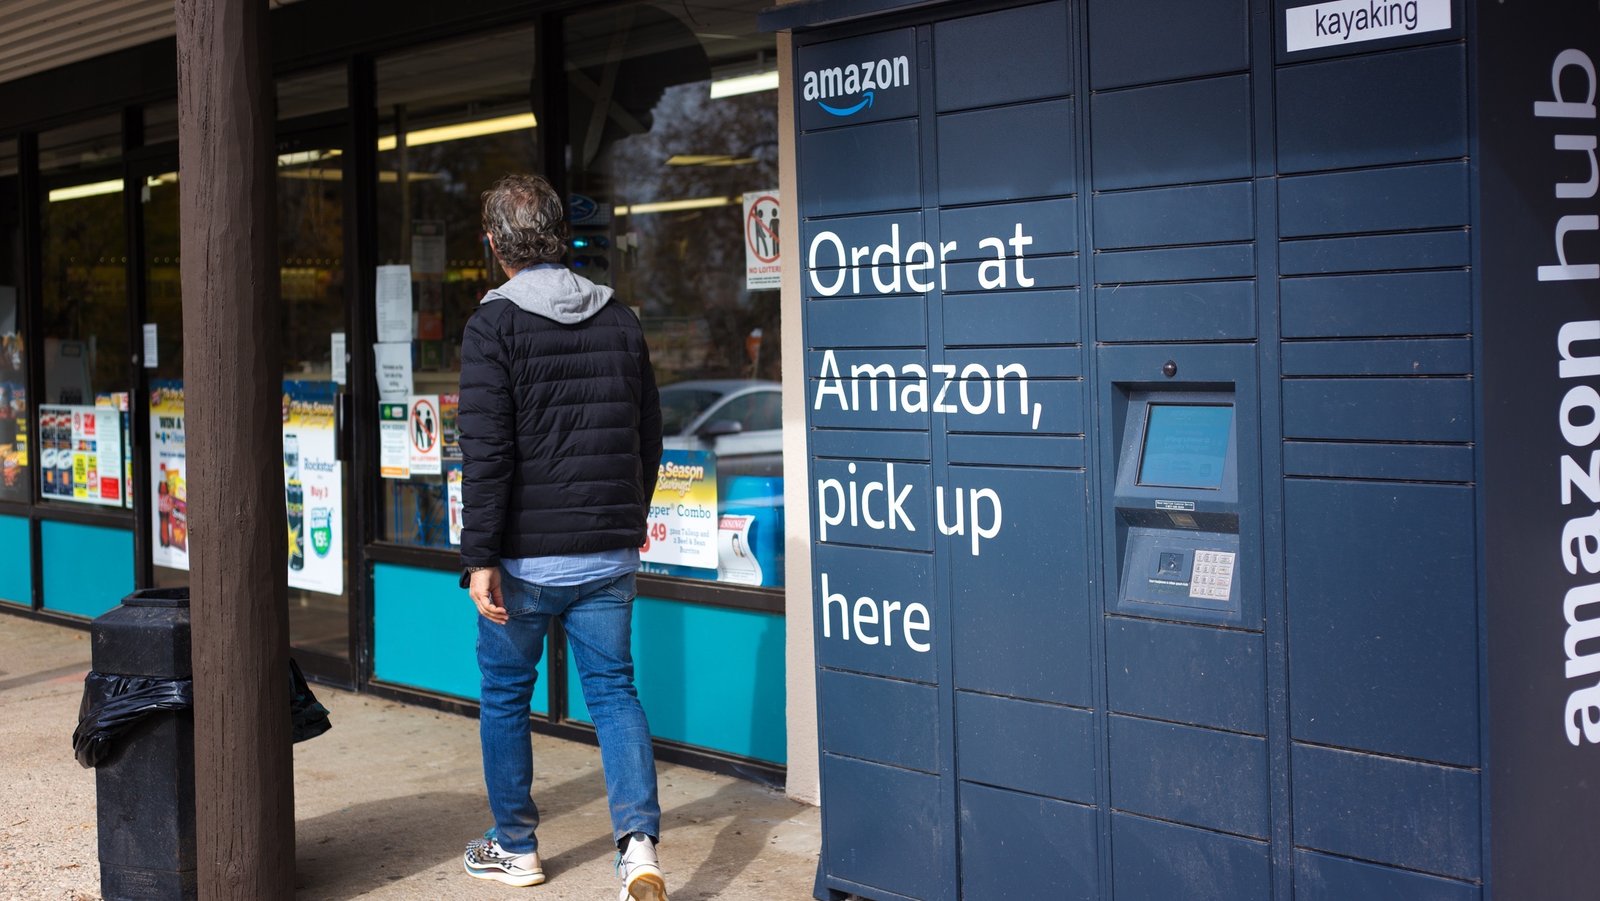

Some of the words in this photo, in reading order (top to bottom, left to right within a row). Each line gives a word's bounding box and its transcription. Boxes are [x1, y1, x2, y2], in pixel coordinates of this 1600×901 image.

[1315, 0, 1418, 40] kayaking
[803, 55, 910, 102] amazon
[1533, 48, 1600, 281] hub
[808, 223, 957, 296] Order
[977, 222, 1035, 289] at
[814, 350, 1042, 430] Amazon,
[159, 416, 175, 429] WIN
[176, 417, 182, 429] A
[304, 457, 333, 472] Rockstar
[665, 461, 703, 479] Season
[311, 485, 322, 500] Buy
[658, 475, 692, 497] Savings!
[649, 505, 671, 518] pper
[676, 504, 712, 519] Combo
[720, 518, 744, 530] ISSING
[818, 462, 916, 542] pick
[936, 485, 1002, 556] up
[1557, 320, 1600, 747] amazon
[821, 572, 931, 652] here
